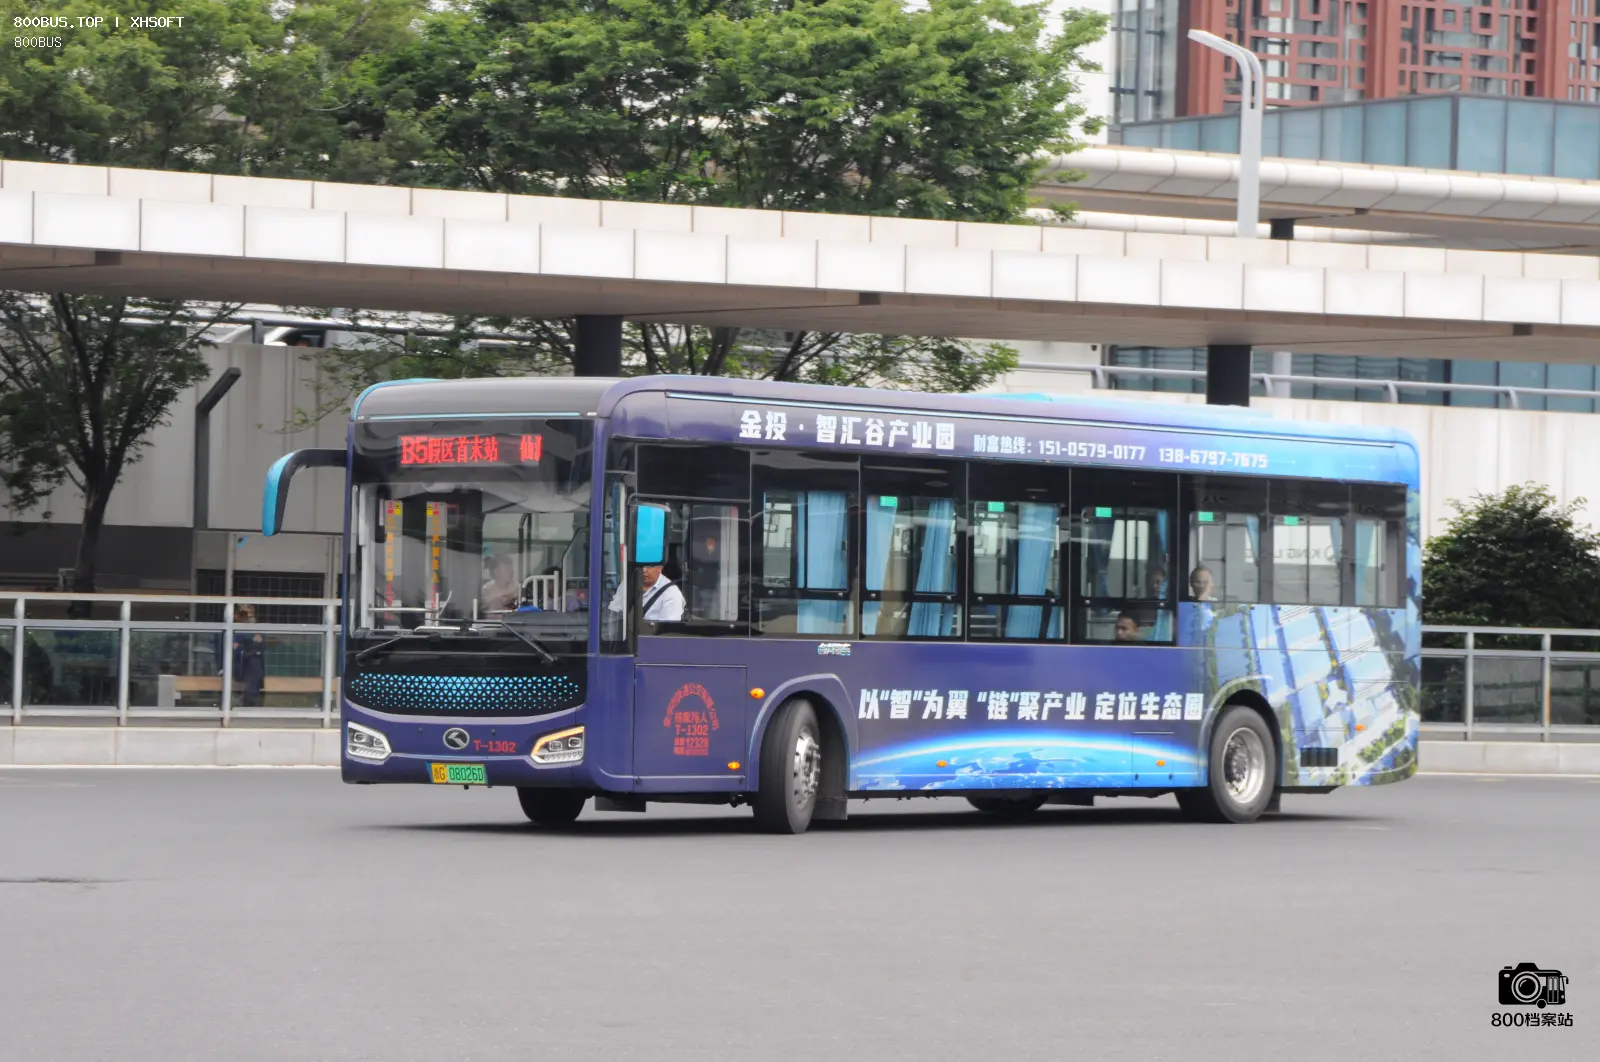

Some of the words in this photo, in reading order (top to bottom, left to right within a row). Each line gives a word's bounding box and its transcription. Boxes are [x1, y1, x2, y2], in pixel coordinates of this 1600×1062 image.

[1038, 439, 1146, 461] 151-0579-0177
[674, 724, 709, 736] T-1302
[473, 739, 517, 753] T-1302
